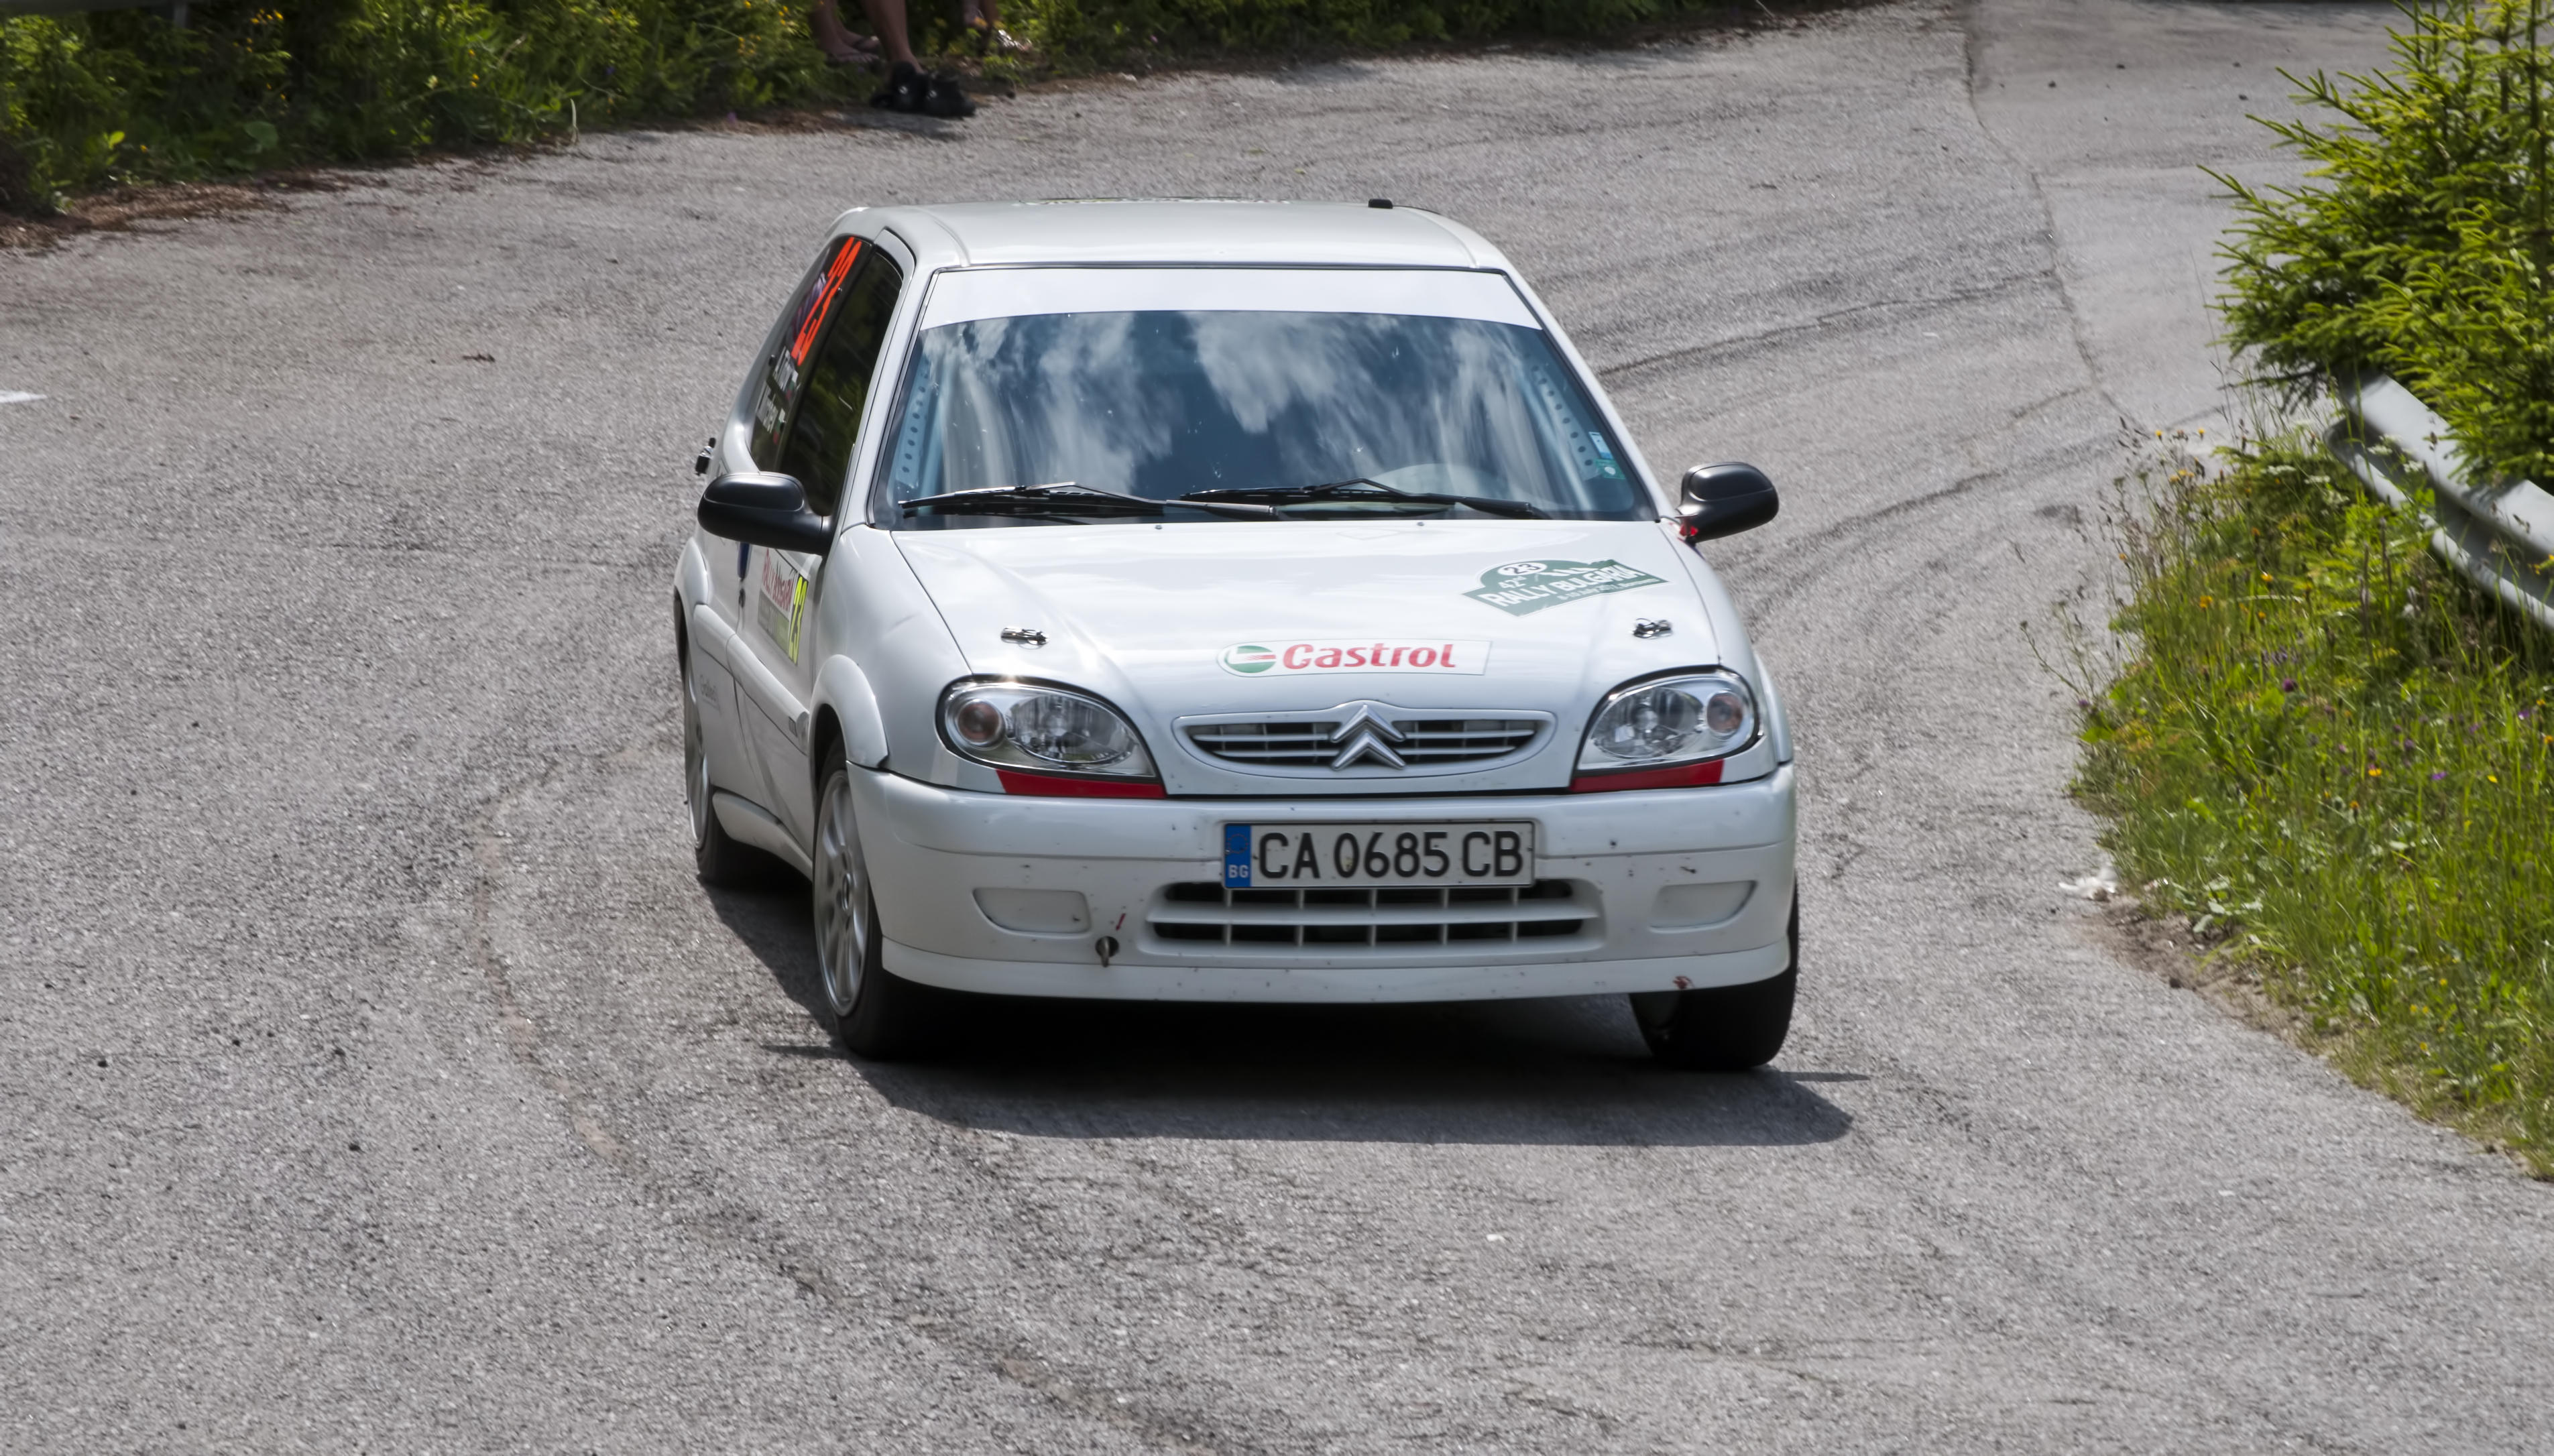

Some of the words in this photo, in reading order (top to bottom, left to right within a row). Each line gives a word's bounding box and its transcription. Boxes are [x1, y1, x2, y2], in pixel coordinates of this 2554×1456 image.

[791, 237, 862, 366] 23
[1477, 585, 1558, 607] RALLY
[1548, 564, 1646, 591] BULGARIA
[1503, 564, 1541, 574] 23
[789, 577, 807, 664] 23
[1282, 643, 1456, 670] Castrol
[1228, 864, 1249, 879] BG
[1259, 832, 1321, 879] CA
[1334, 831, 1450, 879] 0685
[1462, 831, 1524, 877] CB
